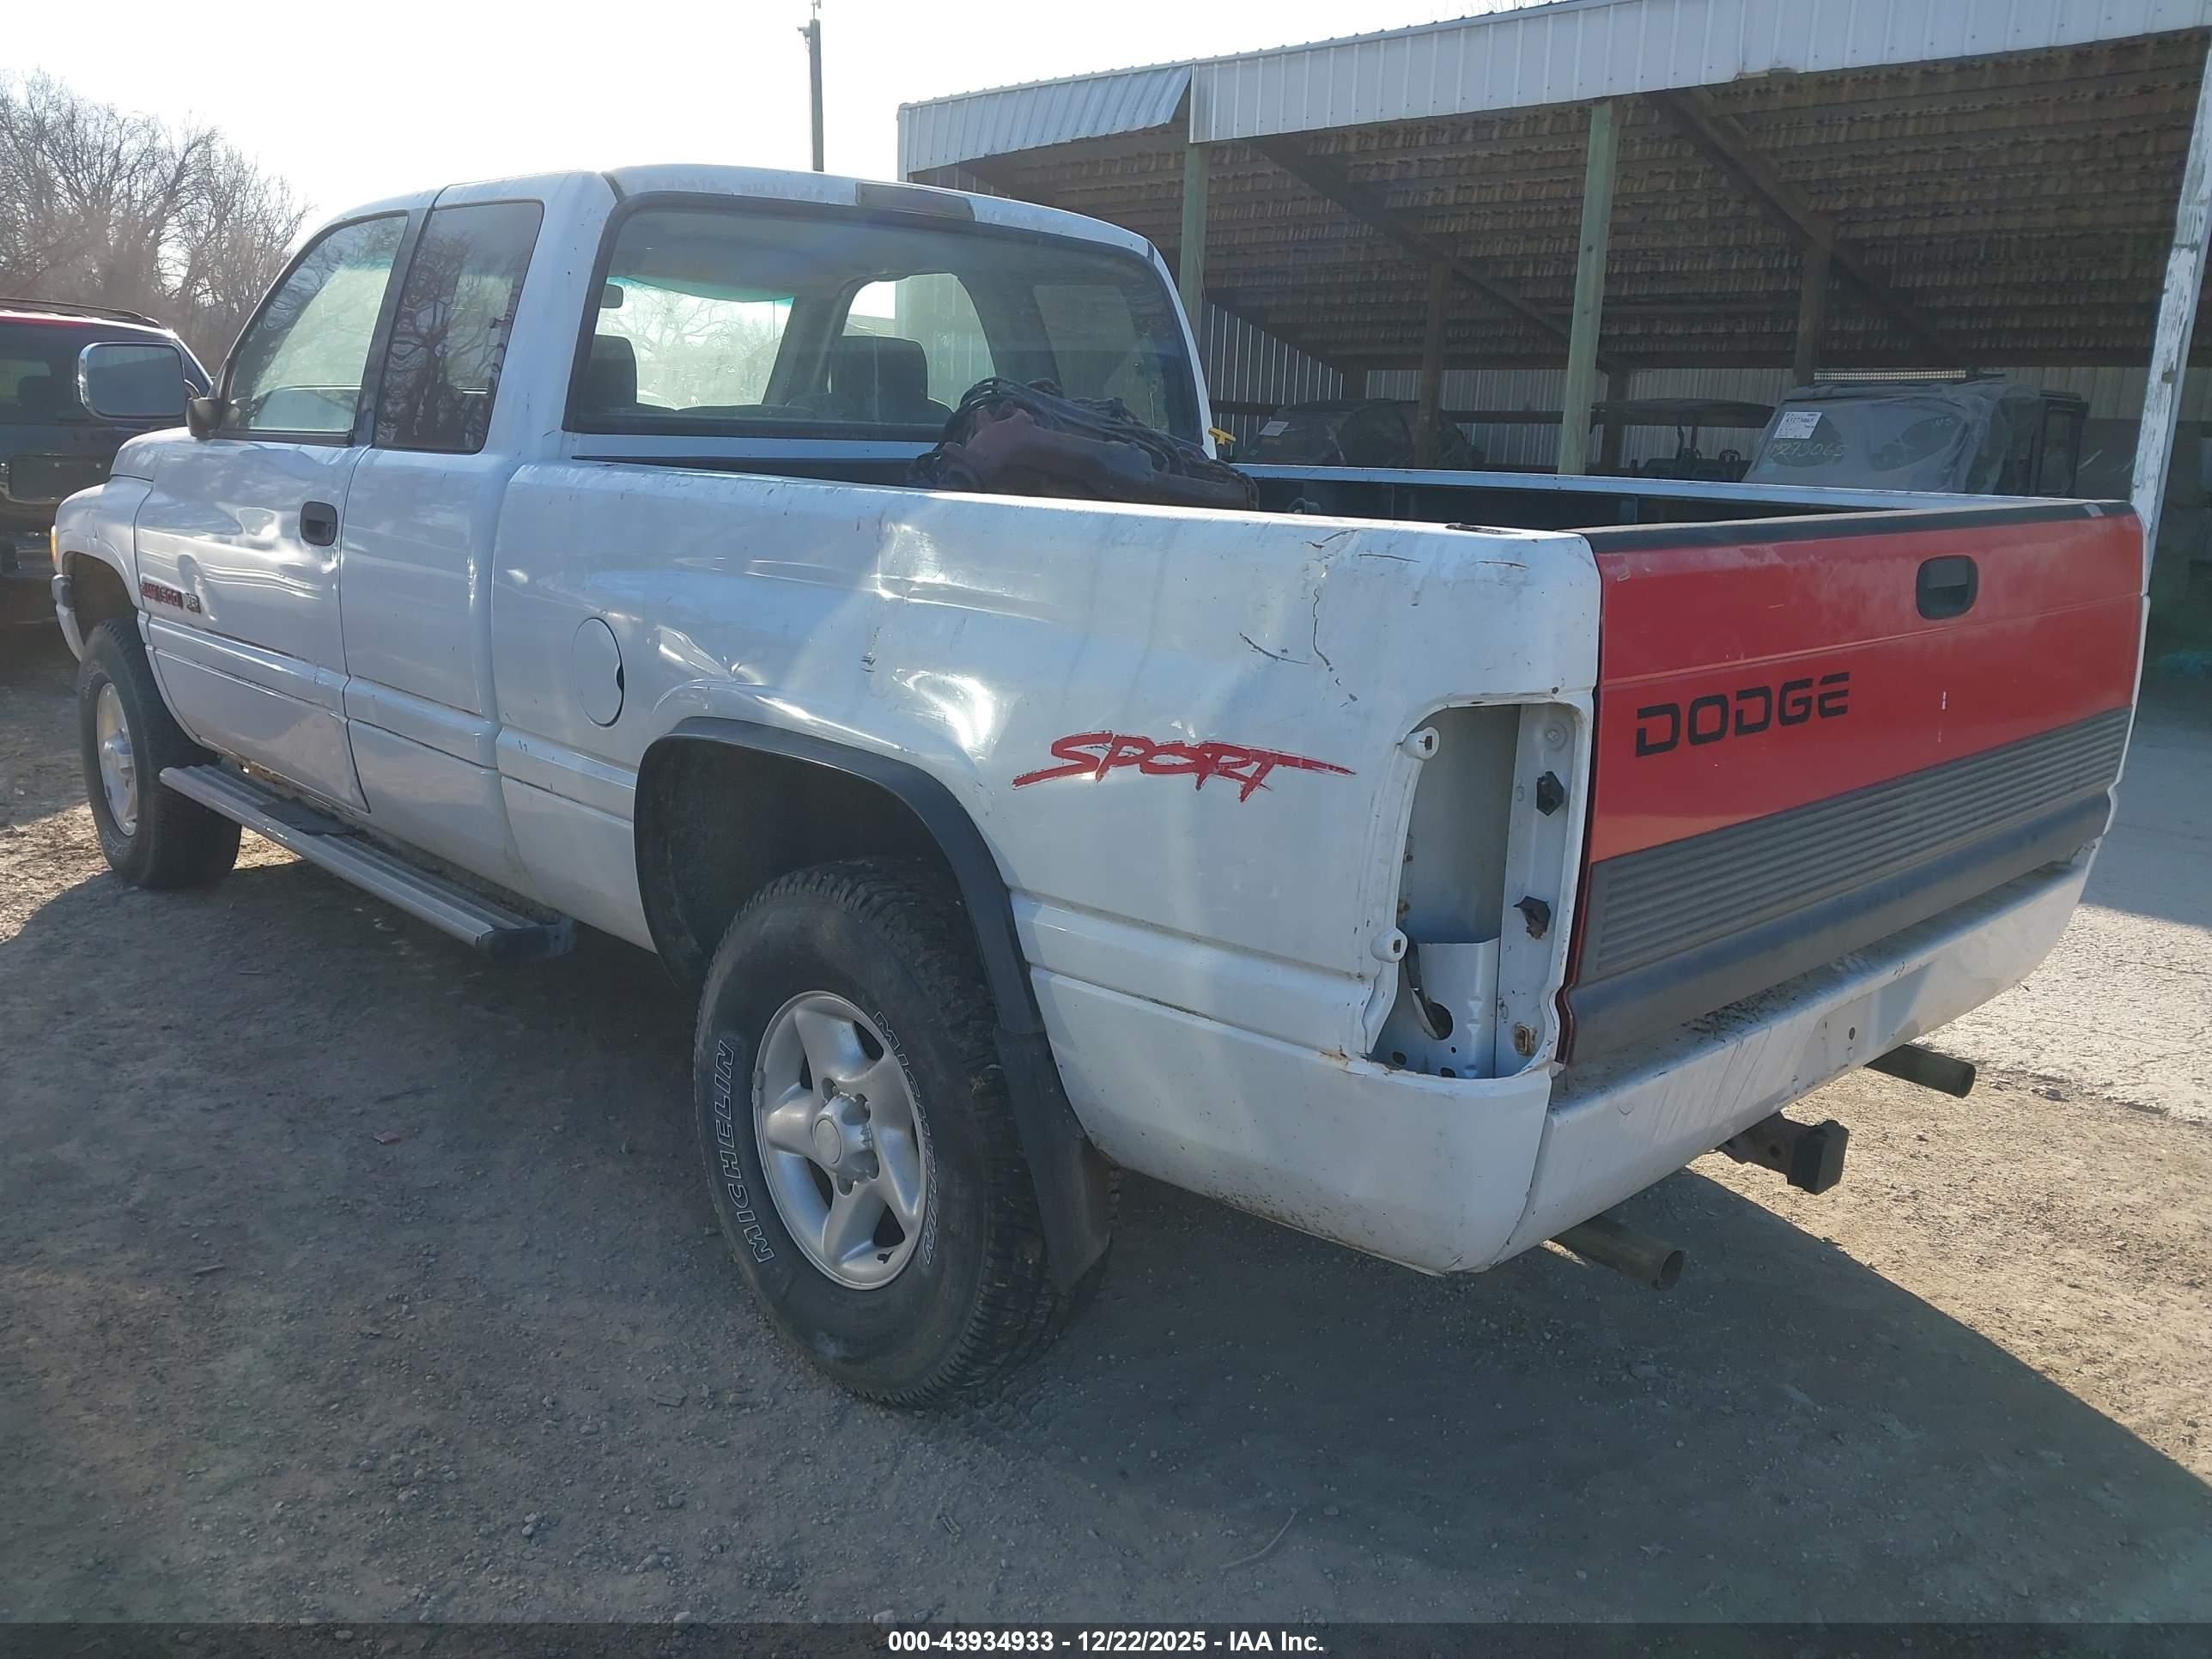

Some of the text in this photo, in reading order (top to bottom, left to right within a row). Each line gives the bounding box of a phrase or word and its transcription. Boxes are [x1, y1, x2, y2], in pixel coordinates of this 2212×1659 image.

[1635, 672, 1850, 757] DODGE
[1011, 730, 1357, 804] SPORT
[714, 1039, 775, 1263] MICHELIN
